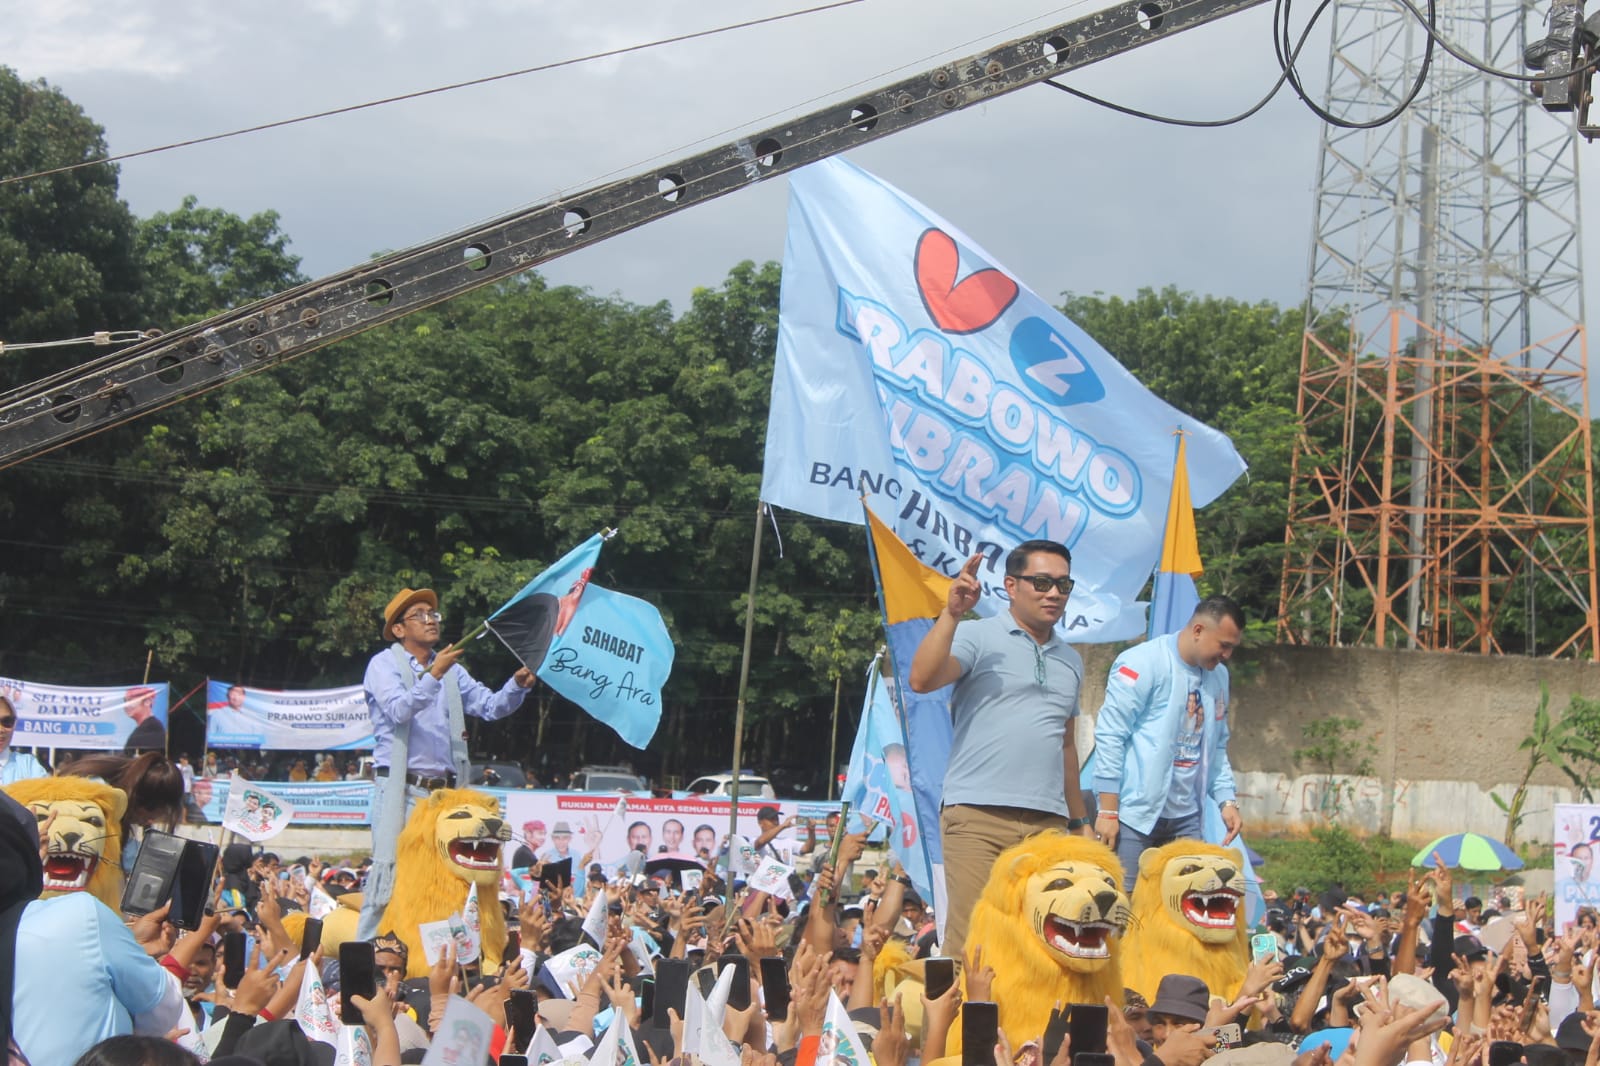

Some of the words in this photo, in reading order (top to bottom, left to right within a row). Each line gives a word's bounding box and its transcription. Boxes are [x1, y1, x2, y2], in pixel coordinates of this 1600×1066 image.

[845, 301, 1137, 507] RABOWO
[882, 396, 1083, 548] IBRAN
[582, 626, 645, 665] SAHABAT
[549, 647, 613, 700] Bang
[616, 671, 655, 706] Ara
[32, 692, 104, 705] SELAMAT
[37, 704, 102, 718] DATANG
[267, 712, 322, 722] PRABOWO
[23, 720, 62, 733] BANG
[68, 722, 97, 735] ARA
[560, 801, 595, 809] RUKUN
[653, 804, 676, 812] KITA
[677, 805, 710, 813] SEMUA
